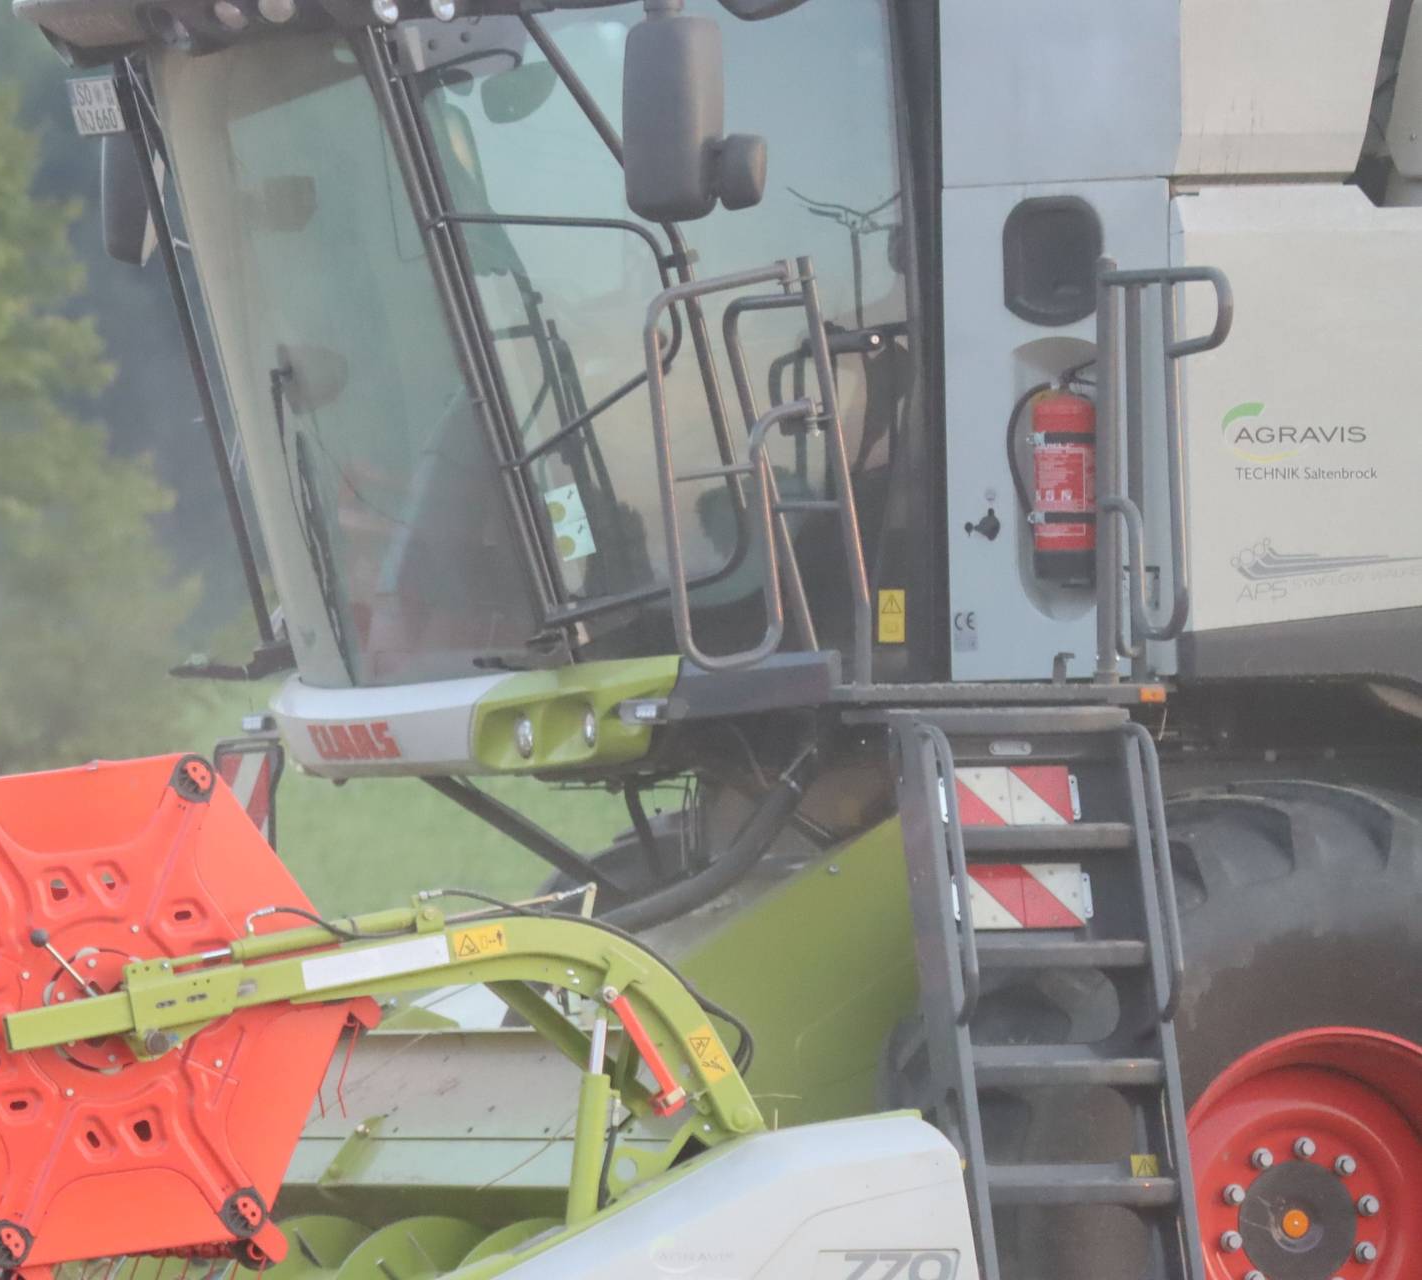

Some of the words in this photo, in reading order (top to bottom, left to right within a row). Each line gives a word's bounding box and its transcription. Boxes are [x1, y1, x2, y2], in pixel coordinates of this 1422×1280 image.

[1234, 426, 1367, 444] AGRAVIS
[1235, 467, 1300, 481] TECHNIK
[1304, 466, 1378, 481] Saltenbrock
[1236, 579, 1288, 603] APS
[954, 612, 976, 631] CE
[307, 722, 402, 760] CLAAS
